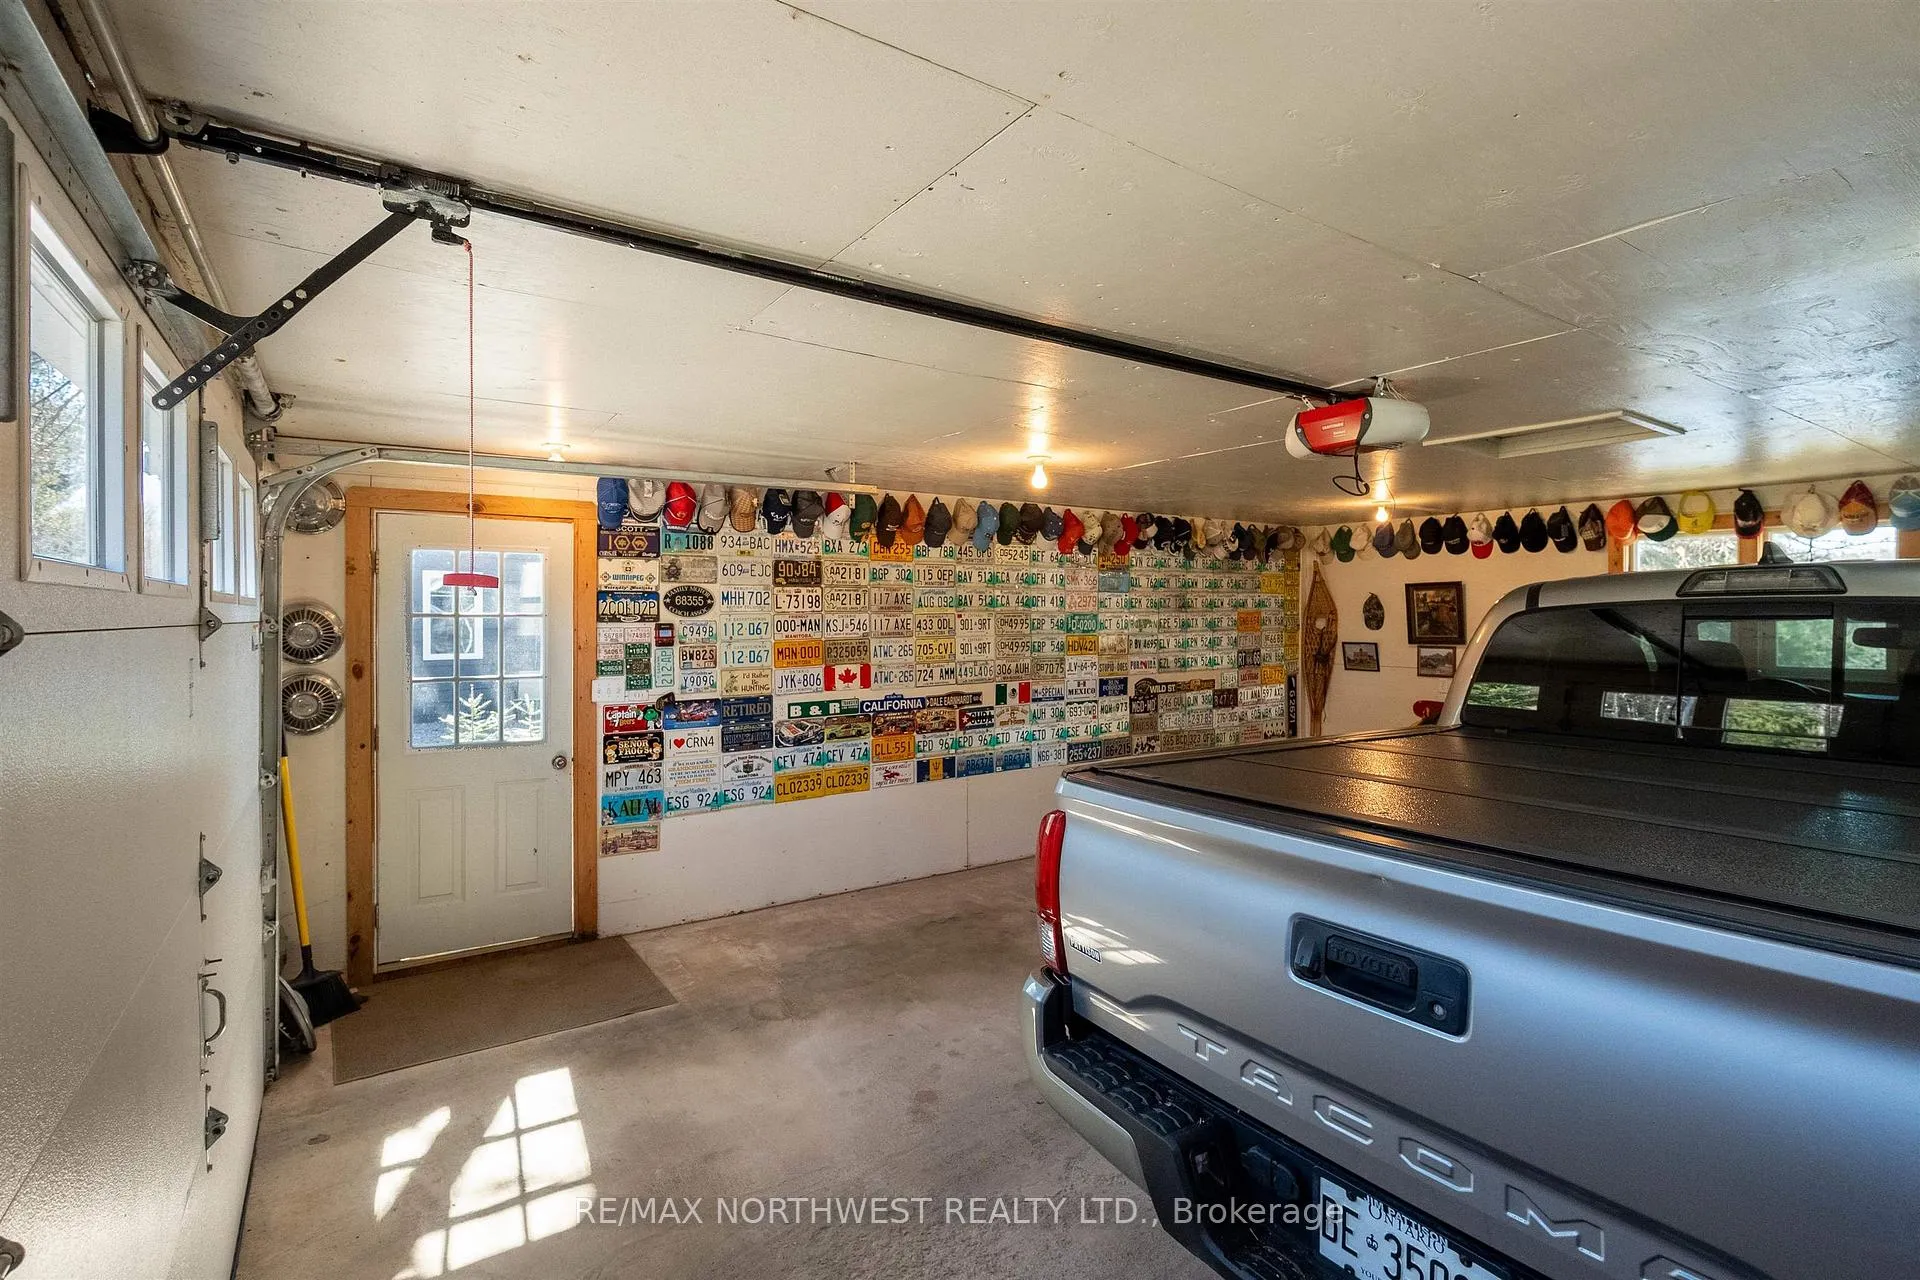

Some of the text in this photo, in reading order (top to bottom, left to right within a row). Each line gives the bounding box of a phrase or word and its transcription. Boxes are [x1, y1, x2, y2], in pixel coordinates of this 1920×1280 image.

[664, 534, 714, 550] R 1088
[721, 536, 770, 550] 934 BAC
[800, 541, 820, 554] 525
[824, 540, 867, 553] BXA 273
[722, 564, 742, 577] 609
[750, 564, 771, 577] EJC
[872, 568, 912, 580] BGP 302
[917, 569, 933, 580] 115
[958, 572, 994, 582] BAV 513
[1050, 574, 1064, 585] 419
[666, 585, 710, 598] FAMILY MOTOR
[675, 595, 704, 606] 68355
[722, 591, 770, 606] MHH 702
[874, 593, 911, 605] 117 AXE
[918, 596, 954, 608] AUG 092
[958, 595, 994, 606] BAV 513
[1050, 596, 1064, 607] 419
[826, 619, 867, 632] KSJ 546
[874, 618, 911, 631] 117 AXE
[916, 619, 934, 631] 433
[960, 618, 972, 631] 901
[682, 649, 714, 661] BW82S
[898, 644, 913, 657] 265
[960, 642, 972, 655] 901
[898, 670, 913, 682] 265
[918, 669, 934, 682] 724
[997, 664, 1030, 675] 306 AUH
[683, 677, 714, 687] Y909G
[778, 673, 822, 689] JYK 806
[741, 684, 770, 692] HUNTING
[863, 699, 923, 712] CALIFORNIA
[930, 695, 973, 707] DALE EARNHARDT
[606, 710, 637, 720] Captain
[723, 702, 770, 717] RETIRED
[790, 706, 802, 717] B
[809, 705, 822, 716] &
[828, 702, 840, 714] R
[1032, 709, 1046, 720] AUH
[971, 711, 993, 724] CUBA
[686, 736, 714, 748] CRN4
[803, 752, 822, 766] 474
[850, 747, 868, 761] 474
[1069, 747, 1101, 762] 255 237
[606, 771, 629, 788] MPY
[638, 768, 662, 784] 463
[724, 785, 772, 802] ESG 924
[608, 797, 660, 818] KAUAI
[667, 794, 718, 810] ESG 924
[1333, 947, 1408, 983] TOYOTA
[1368, 1201, 1446, 1254] ONTARIO
